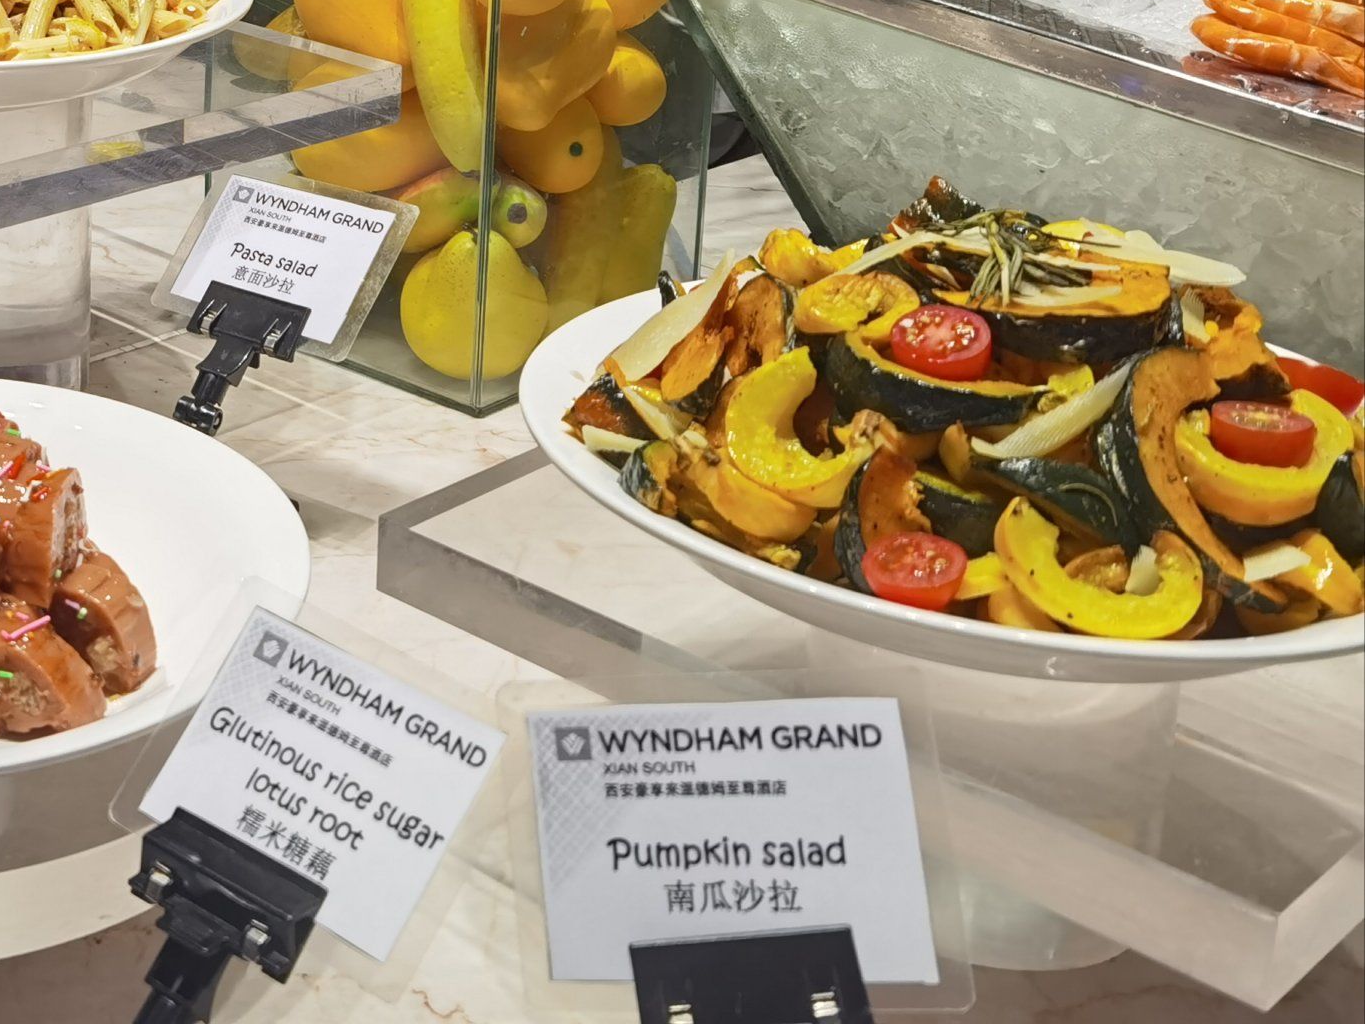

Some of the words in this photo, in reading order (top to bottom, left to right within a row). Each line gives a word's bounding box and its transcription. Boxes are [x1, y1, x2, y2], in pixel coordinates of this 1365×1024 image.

[249, 207, 265, 216] XIAN
[266, 211, 292, 223] SOUTH
[255, 191, 331, 221] WYNDHAM
[332, 212, 384, 234] GRAND
[230, 241, 273, 267] Pasta
[276, 258, 319, 278] salad
[231, 264, 295, 295] 意面沙拉
[276, 675, 301, 695] XIAN
[302, 689, 342, 716] SOUTH
[288, 648, 405, 725] WYNDHAM
[405, 713, 487, 768] GRAND
[598, 726, 763, 754] WYNDHAM
[771, 723, 883, 751] GRAND
[209, 705, 323, 782] Glutinous
[324, 767, 374, 812] rice
[374, 799, 445, 850] sugar
[603, 762, 638, 775] XIAN
[642, 760, 696, 775] SOUTH
[245, 767, 308, 817] lotus
[308, 805, 365, 851] root
[236, 804, 338, 881] 糯米糖藕
[606, 836, 751, 871] Pumpkin
[762, 835, 847, 868] salad
[664, 880, 803, 913] 南瓜沙拉
